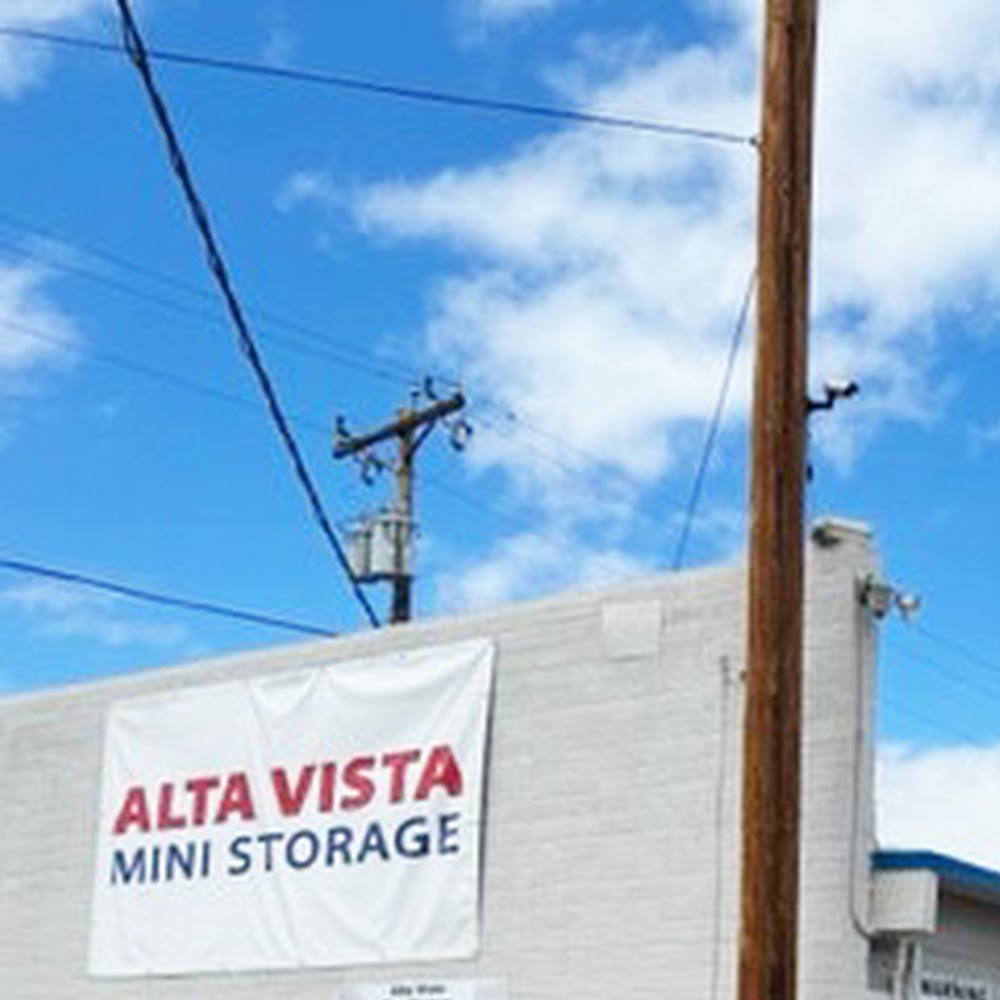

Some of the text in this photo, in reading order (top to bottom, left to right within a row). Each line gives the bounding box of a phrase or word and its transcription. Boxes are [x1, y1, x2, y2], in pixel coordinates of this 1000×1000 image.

[112, 745, 463, 835] ALTA VISTA
[110, 813, 461, 886] MINI STORAGE
